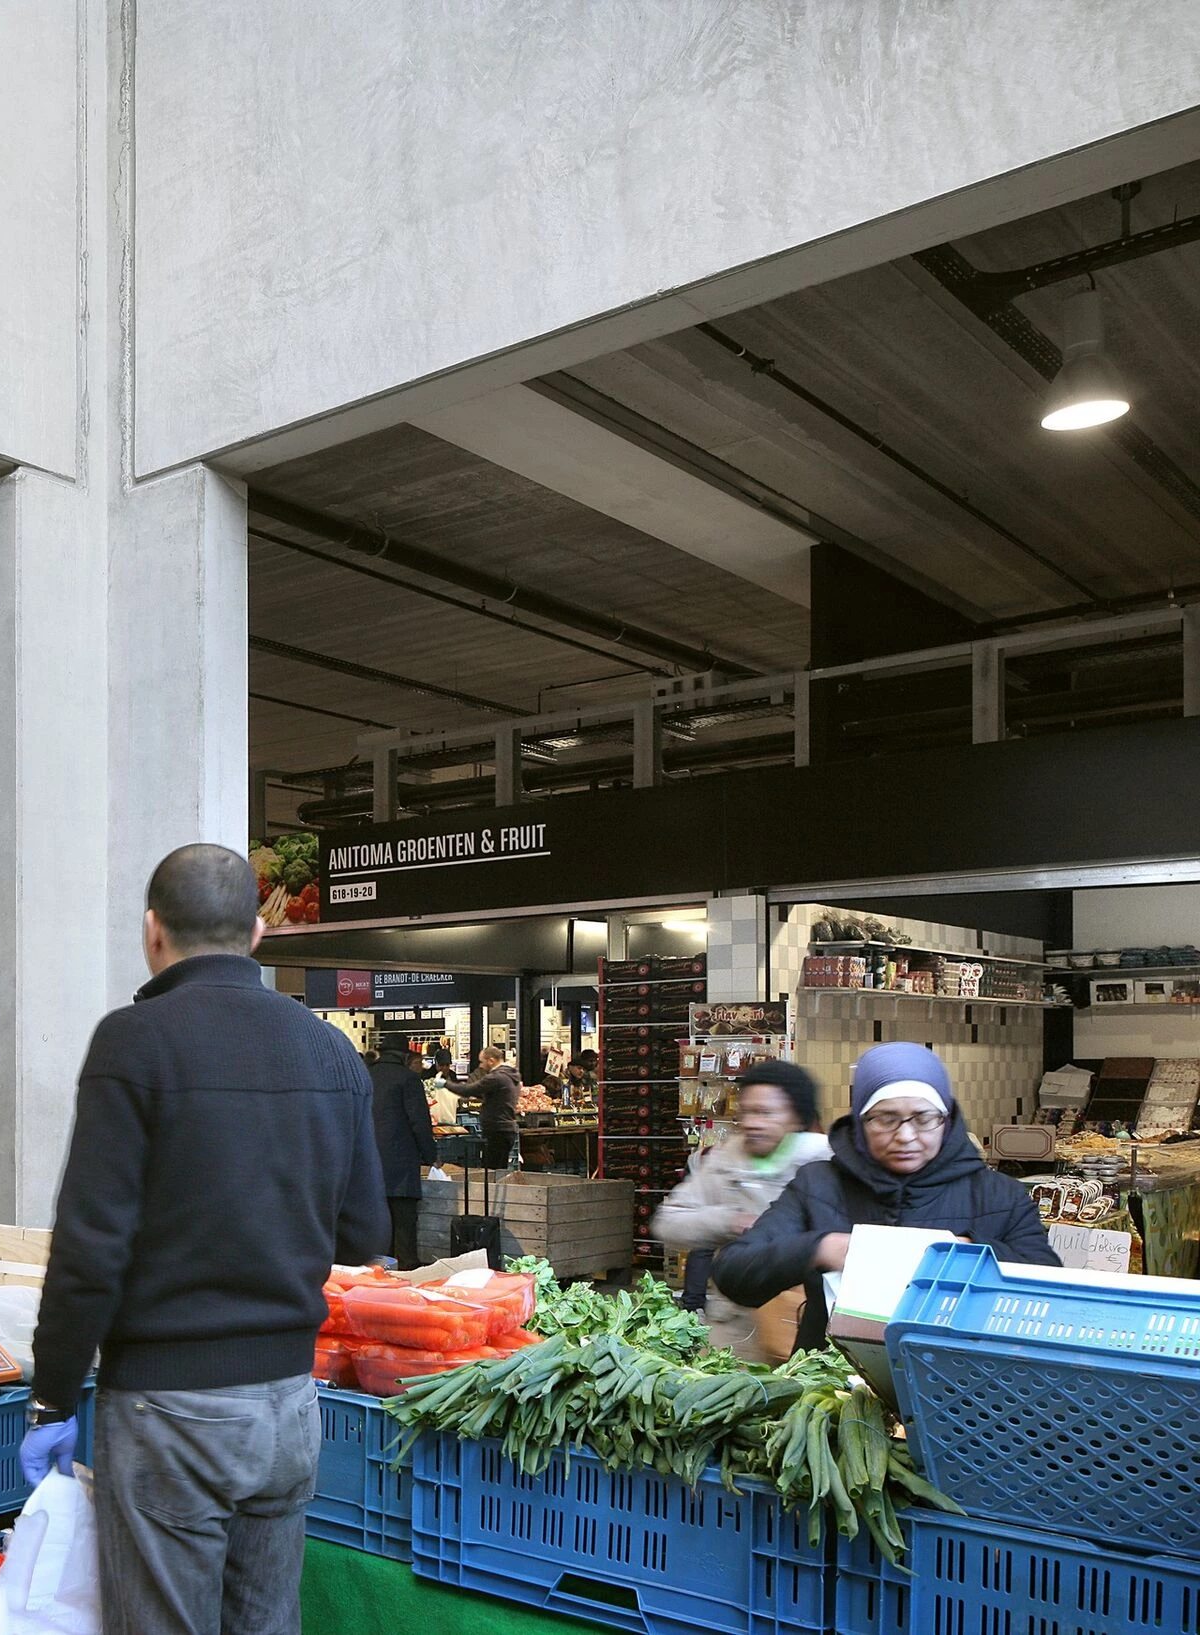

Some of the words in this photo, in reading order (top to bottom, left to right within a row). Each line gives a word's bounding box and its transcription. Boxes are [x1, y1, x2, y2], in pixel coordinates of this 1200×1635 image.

[328, 841, 393, 870] ANITOMA
[397, 831, 474, 863] GROENTEN
[480, 828, 495, 853] &
[500, 823, 546, 851] FRUIT
[375, 974, 383, 984] DE
